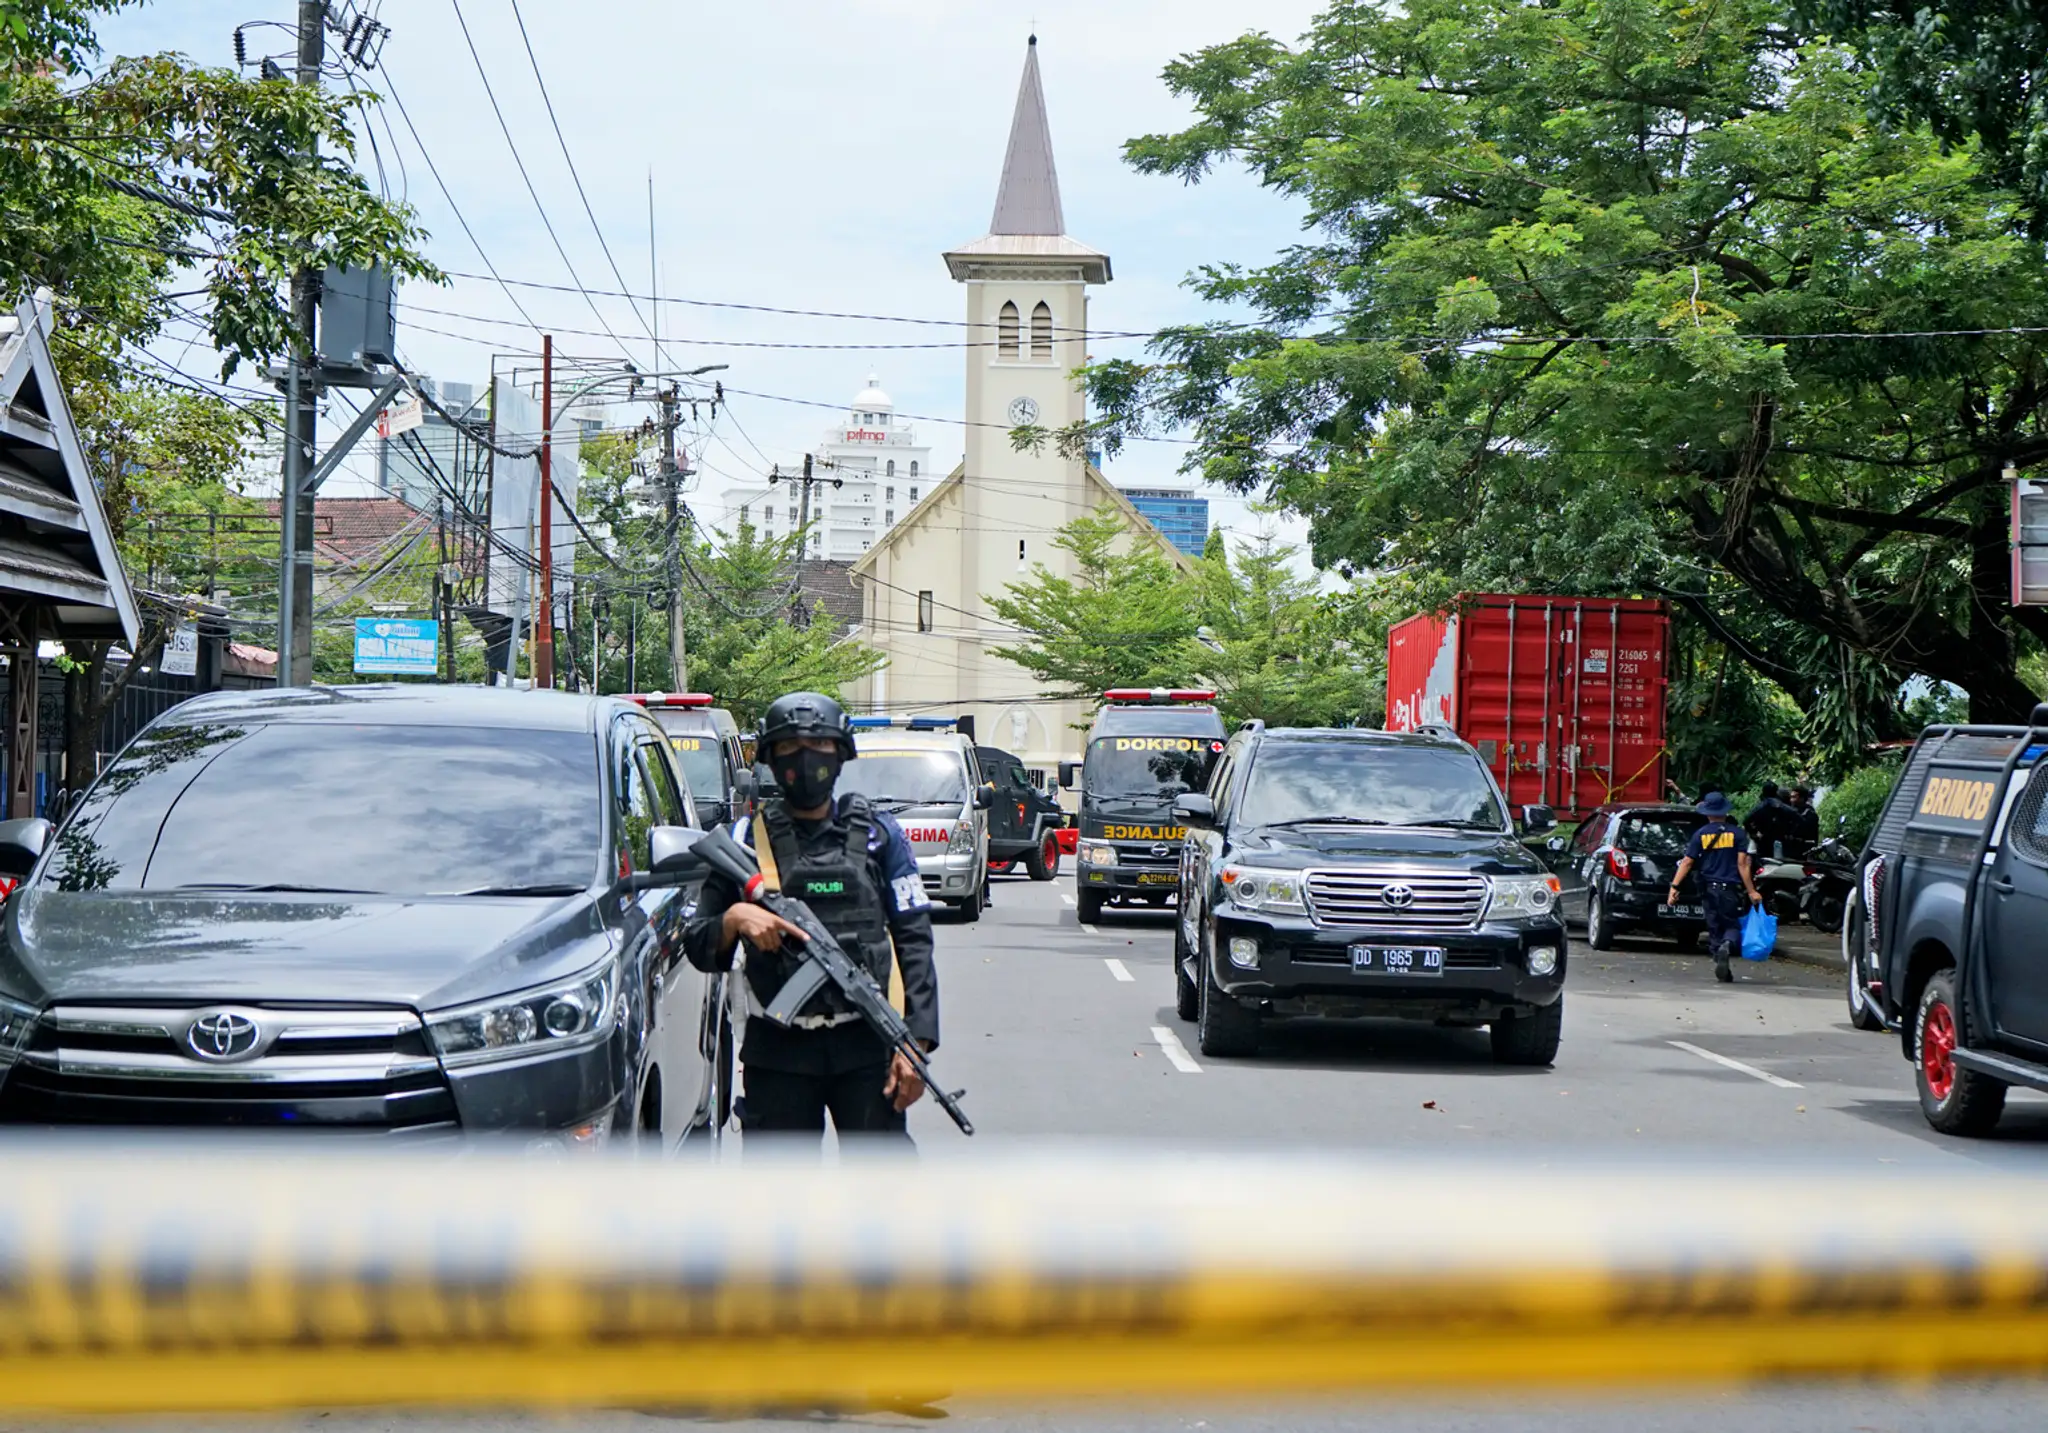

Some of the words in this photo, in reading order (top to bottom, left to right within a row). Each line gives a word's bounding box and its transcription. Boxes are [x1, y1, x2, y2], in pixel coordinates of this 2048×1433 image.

[847, 428, 885, 441] prima
[1618, 649, 1648, 661] 216065
[1654, 650, 1661, 661] 4
[1116, 738, 1206, 752] DOKPOL
[1920, 777, 1995, 820] BRIMOB
[807, 881, 843, 893] POLISI
[1355, 949, 1372, 965] DD
[1383, 950, 1413, 966] 1965
[1423, 951, 1440, 967] AD
